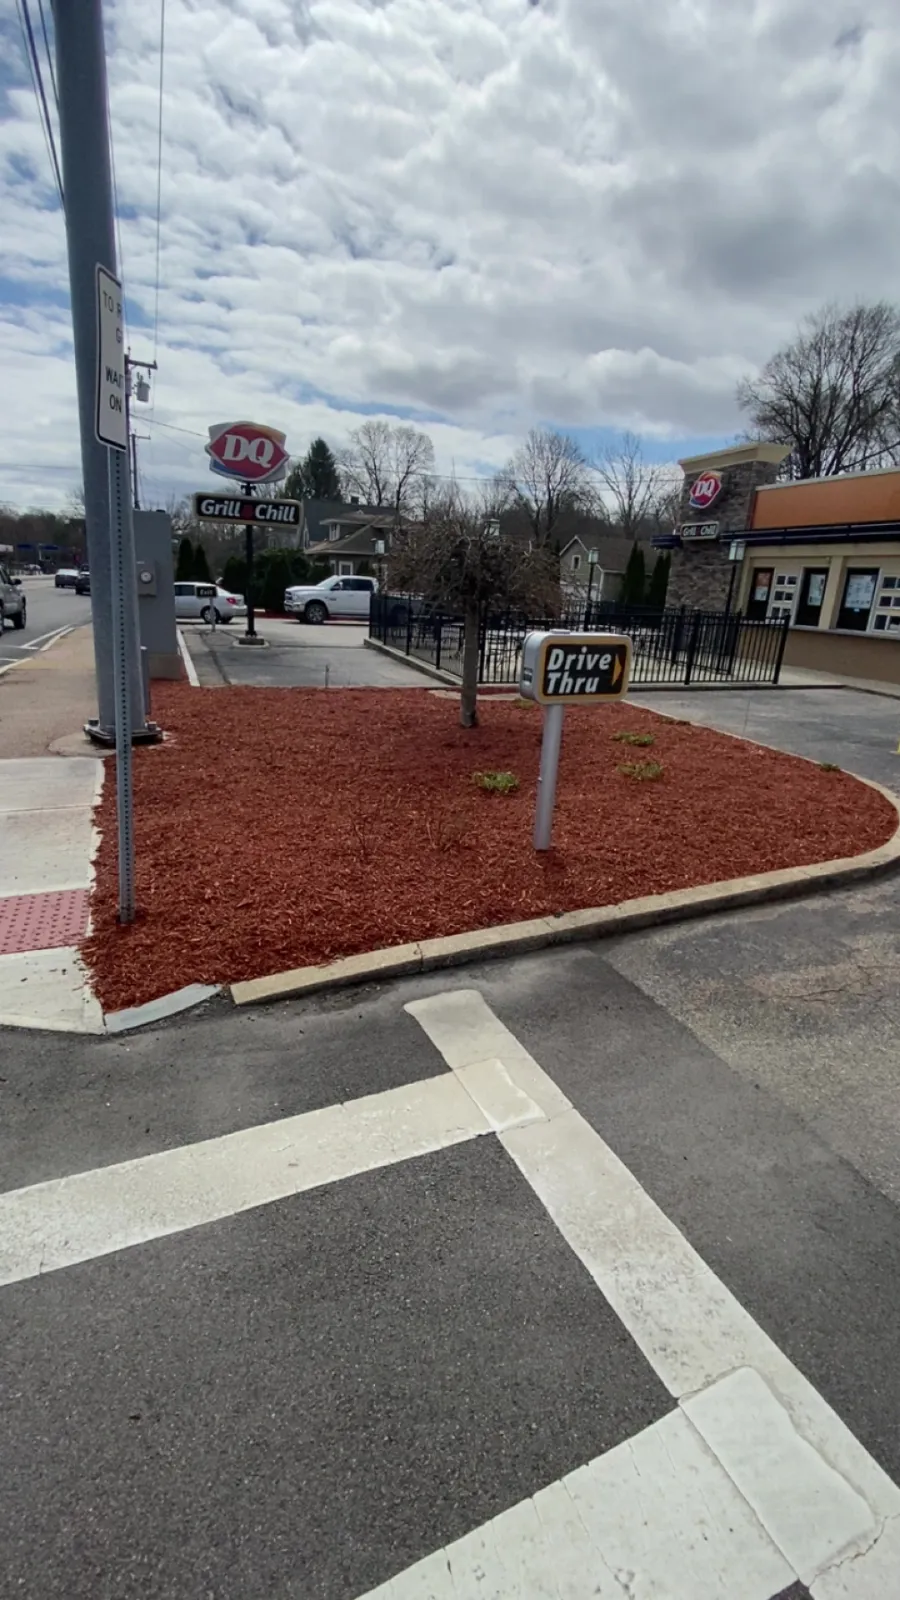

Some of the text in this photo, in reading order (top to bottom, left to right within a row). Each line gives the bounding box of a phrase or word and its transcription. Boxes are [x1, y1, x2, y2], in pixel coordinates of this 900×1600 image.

[222, 434, 274, 468] DQ
[695, 479, 715, 496] DQ
[200, 499, 296, 522] Grill Chill
[547, 646, 612, 670] Drive
[547, 671, 600, 693] Thru
